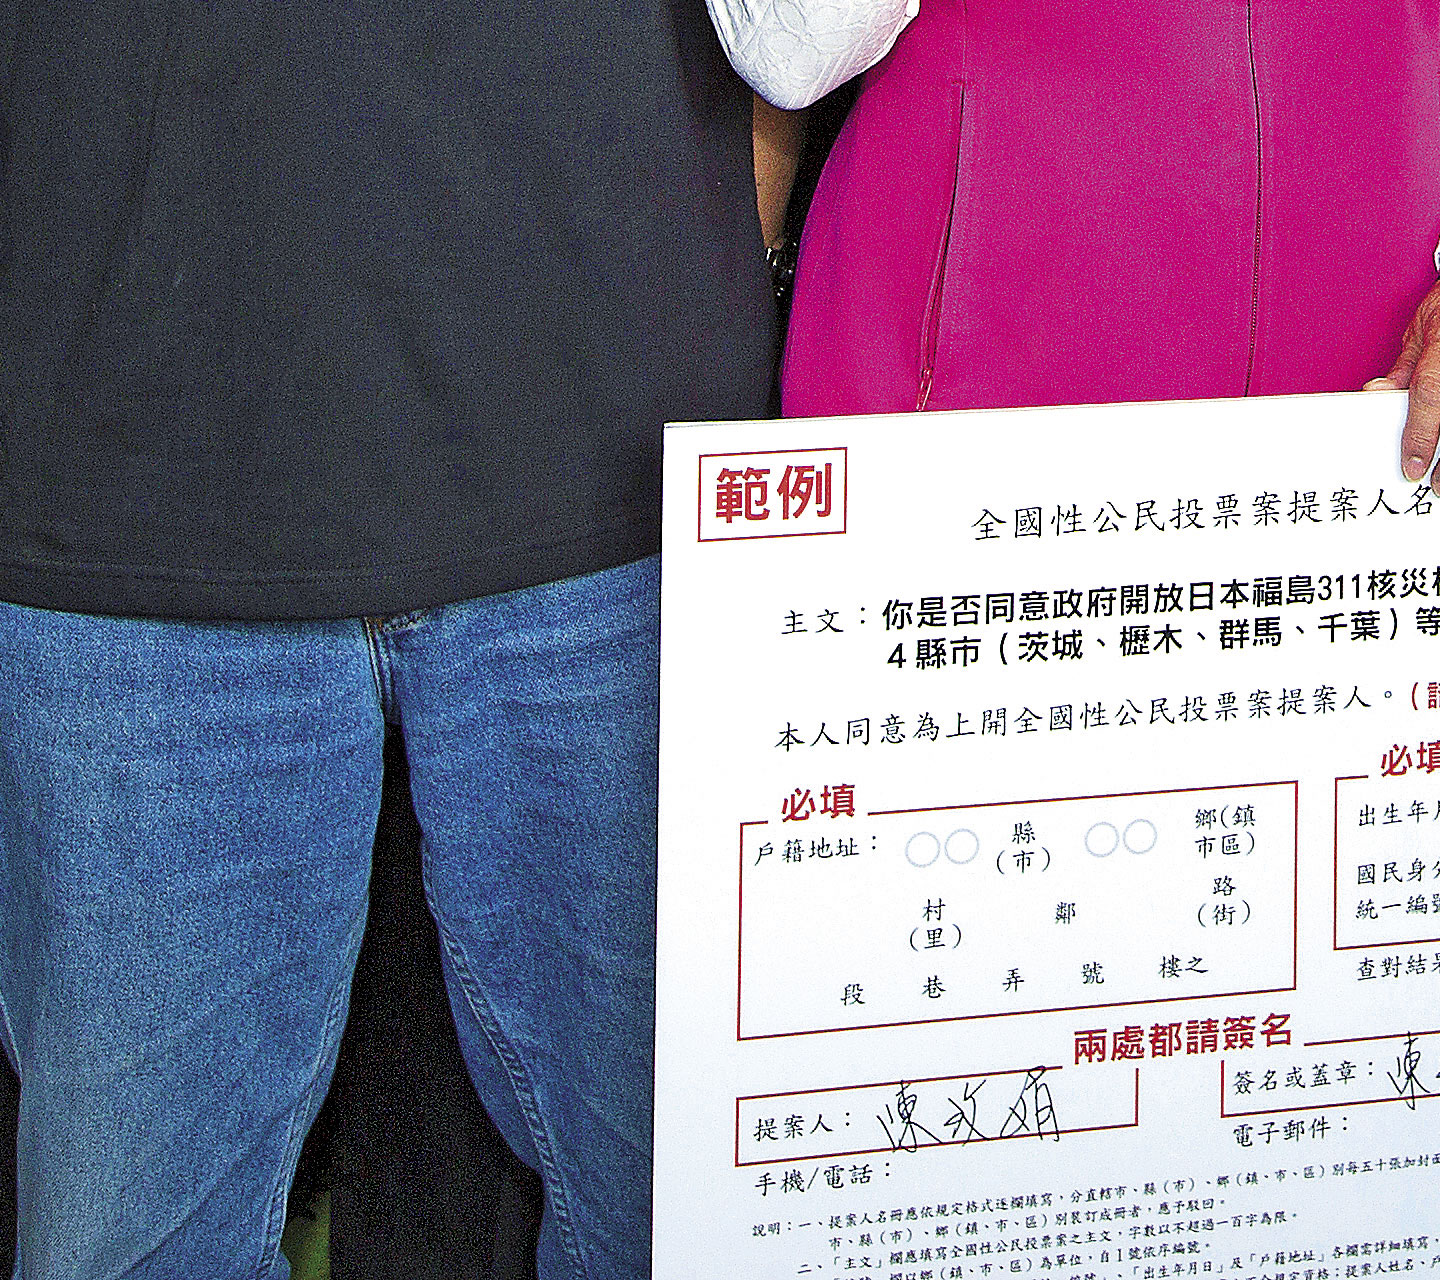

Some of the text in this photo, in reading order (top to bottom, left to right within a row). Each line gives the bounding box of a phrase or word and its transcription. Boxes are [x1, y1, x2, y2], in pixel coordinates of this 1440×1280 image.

[715, 462, 832, 524] 範例
[780, 782, 856, 824] 必填
[1073, 1010, 1291, 1066] 兩處都請簽名
